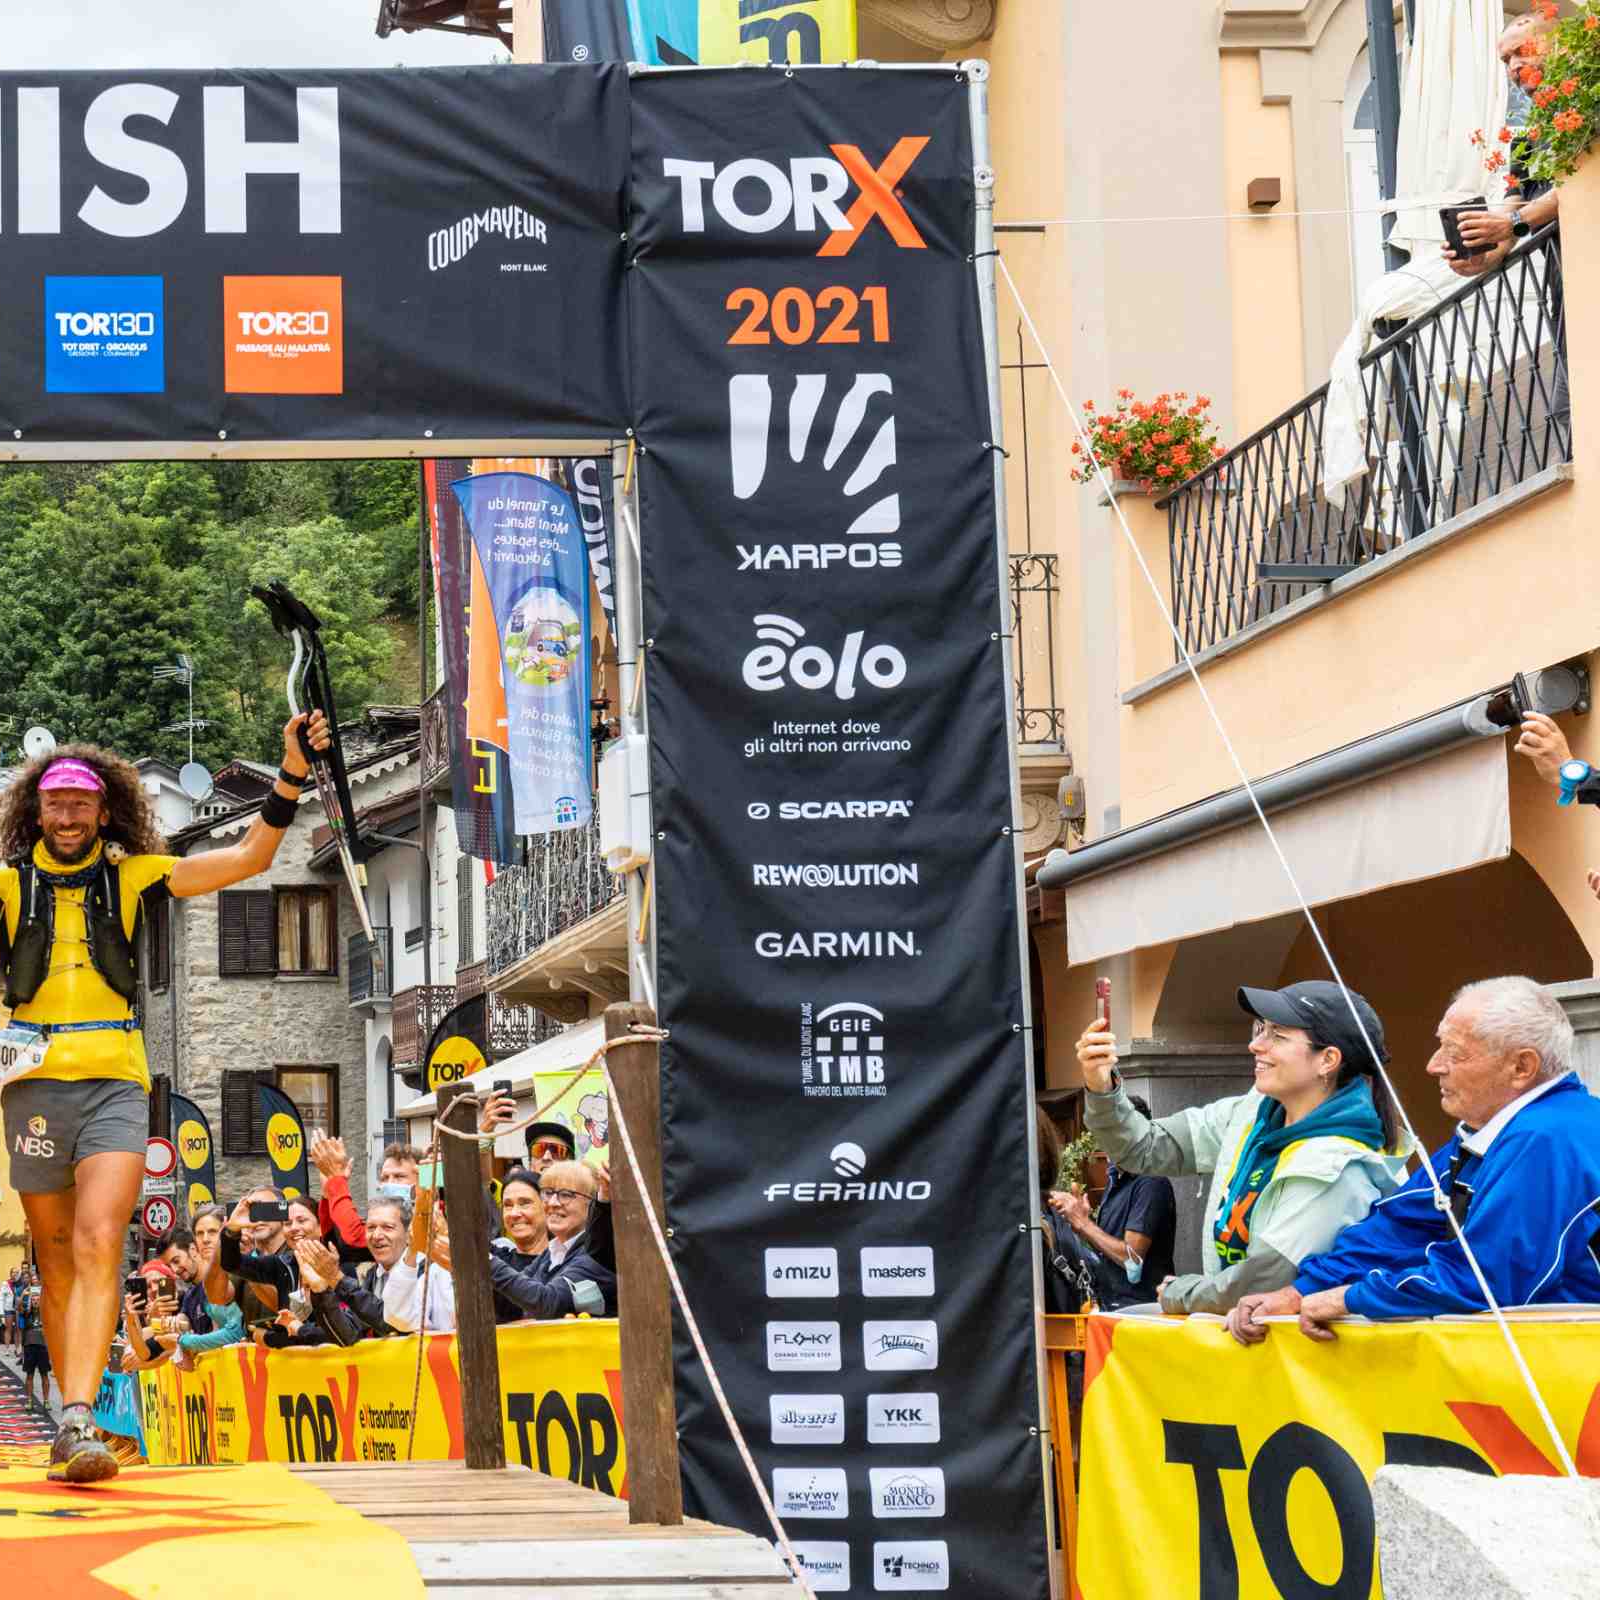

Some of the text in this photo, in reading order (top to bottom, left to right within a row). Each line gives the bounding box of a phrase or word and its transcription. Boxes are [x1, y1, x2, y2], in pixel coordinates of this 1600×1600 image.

[663, 136, 931, 257] TORX
[428, 204, 548, 271] COURMAYEUR
[500, 263, 548, 272] MONT BLANC
[55, 312, 154, 336] TOR130
[238, 311, 328, 336] TOR30
[725, 286, 891, 346] 2021
[736, 543, 902, 570] KARPOS
[742, 630, 907, 700] eolo
[773, 719, 881, 735] Internet dove
[744, 737, 911, 757] gli altri non arrivano
[779, 800, 911, 819] SCARPA
[830, 1019, 871, 1032] GEIE
[816, 1056, 885, 1084] TMB
[15, 1135, 55, 1158] NBS
[763, 1181, 931, 1202] FERRINO
[869, 1265, 926, 1278] masters
[279, 1365, 359, 1462] TORX
[360, 1402, 414, 1430] eXtraordinar
[884, 1409, 922, 1421] YKK
[363, 1434, 396, 1462] eXtreme
[883, 1494, 935, 1506] BIANCO
[889, 1486, 927, 1496] MONTE
